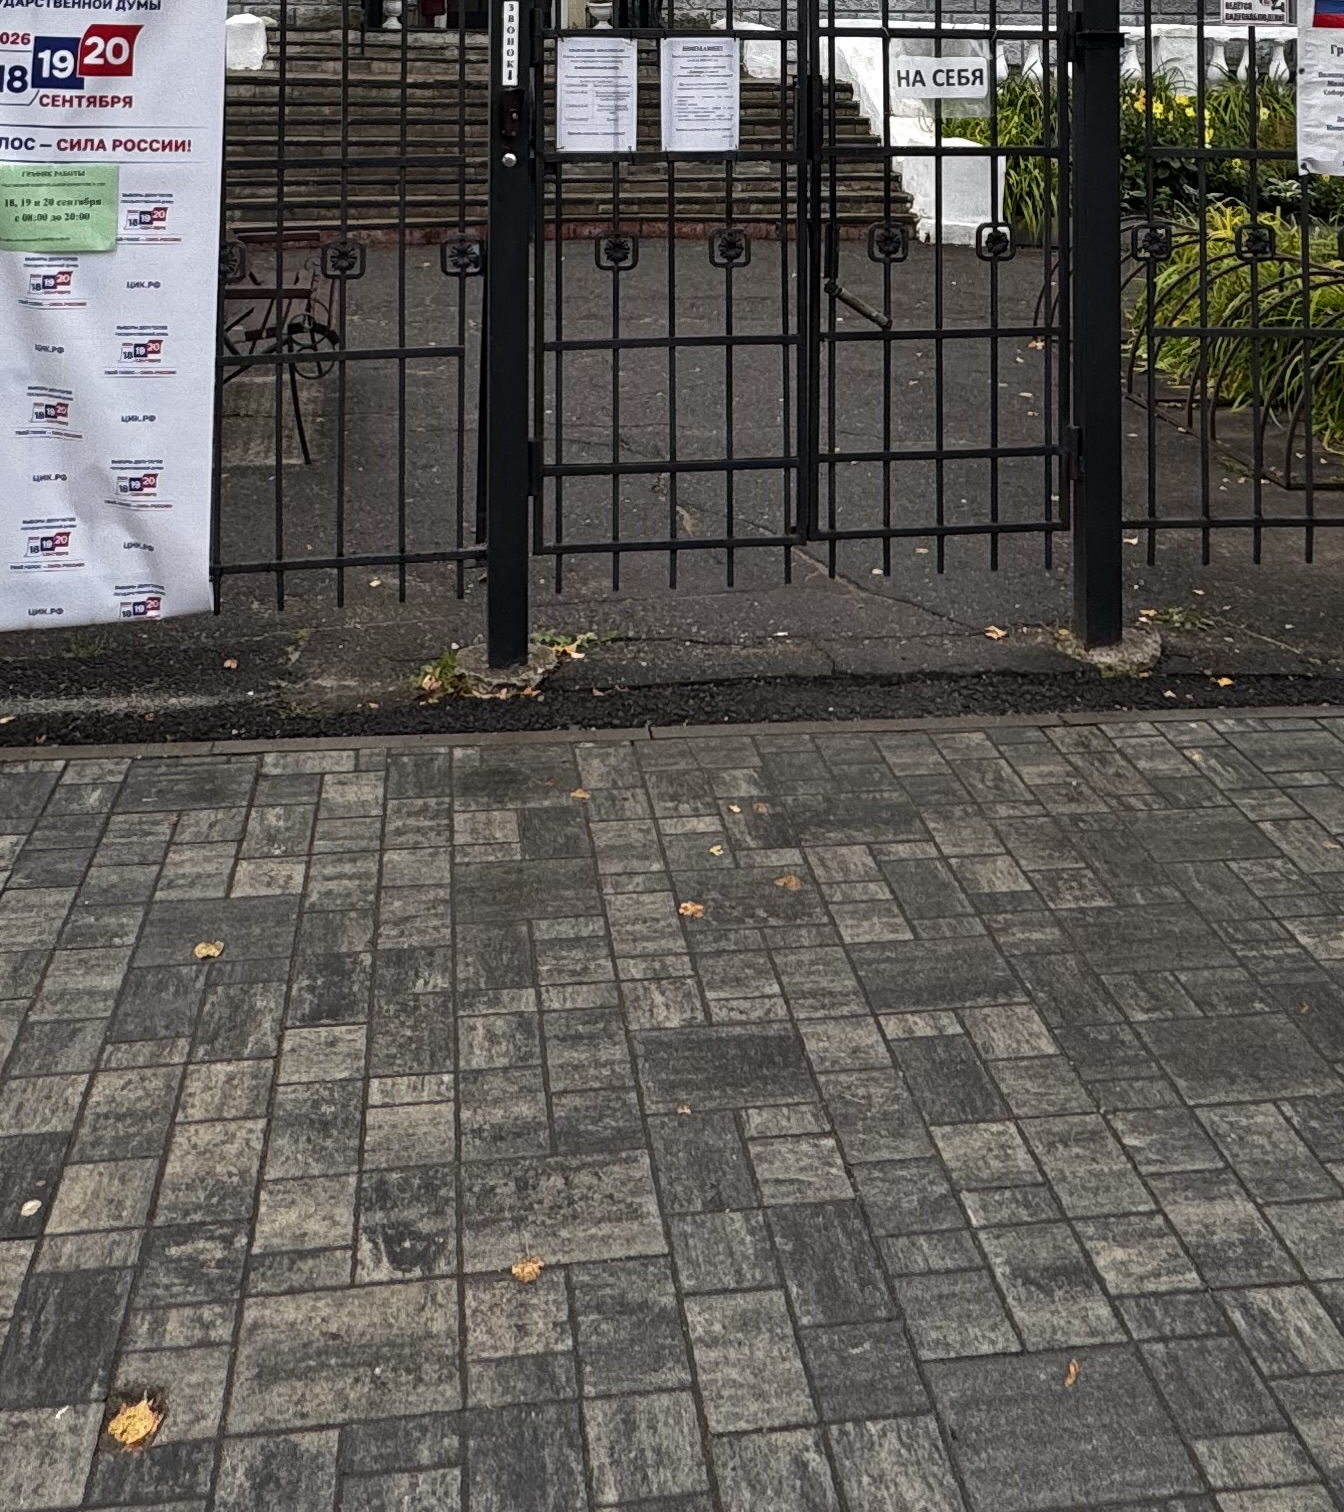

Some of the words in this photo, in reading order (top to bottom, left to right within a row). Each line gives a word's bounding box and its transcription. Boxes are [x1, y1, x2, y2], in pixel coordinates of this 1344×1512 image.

[115, 0, 162, 12] ДУМЫ
[37, 49, 75, 79] 19
[83, 35, 131, 66] 20
[896, 69, 926, 88] НА
[932, 68, 984, 87] СЕБЯ
[38, 93, 133, 109] СЕНТЯБРЯ
[56, 138, 106, 152] СИЛА
[112, 138, 192, 153] РОССИИ!
[21, 198, 31, 207] 19
[43, 197, 54, 206] 20
[56, 197, 102, 208] сентября
